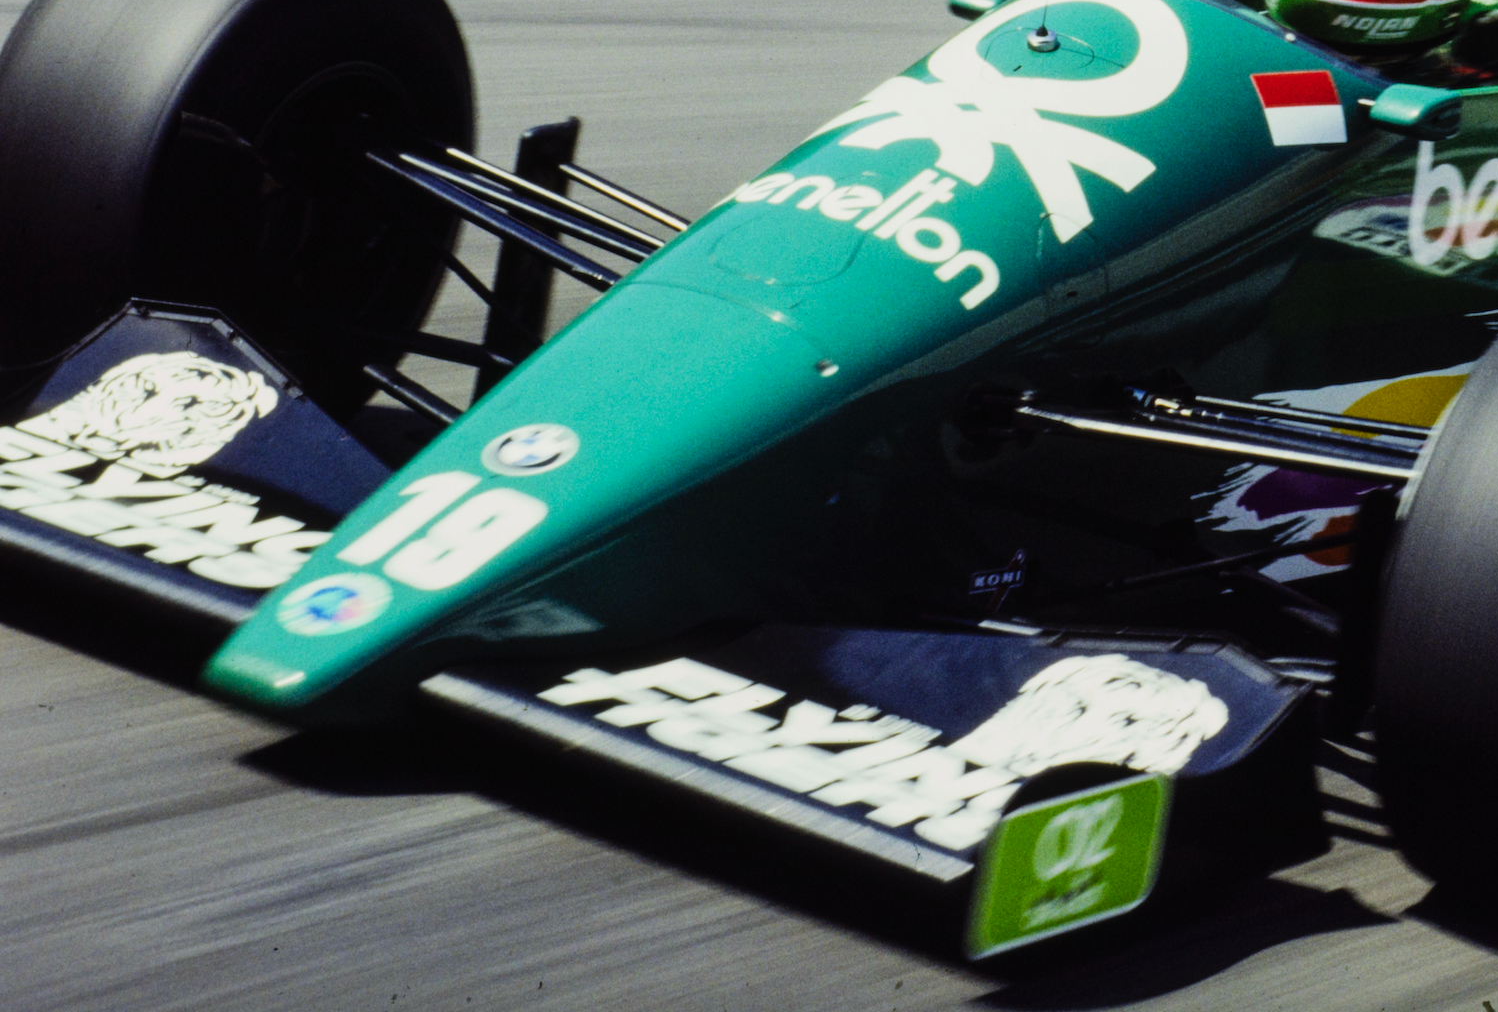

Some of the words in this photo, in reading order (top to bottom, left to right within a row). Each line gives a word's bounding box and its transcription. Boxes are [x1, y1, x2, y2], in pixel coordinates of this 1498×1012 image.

[1331, 14, 1421, 38] NOLAN
[733, 168, 1000, 310] enetton
[336, 470, 549, 590] 19
